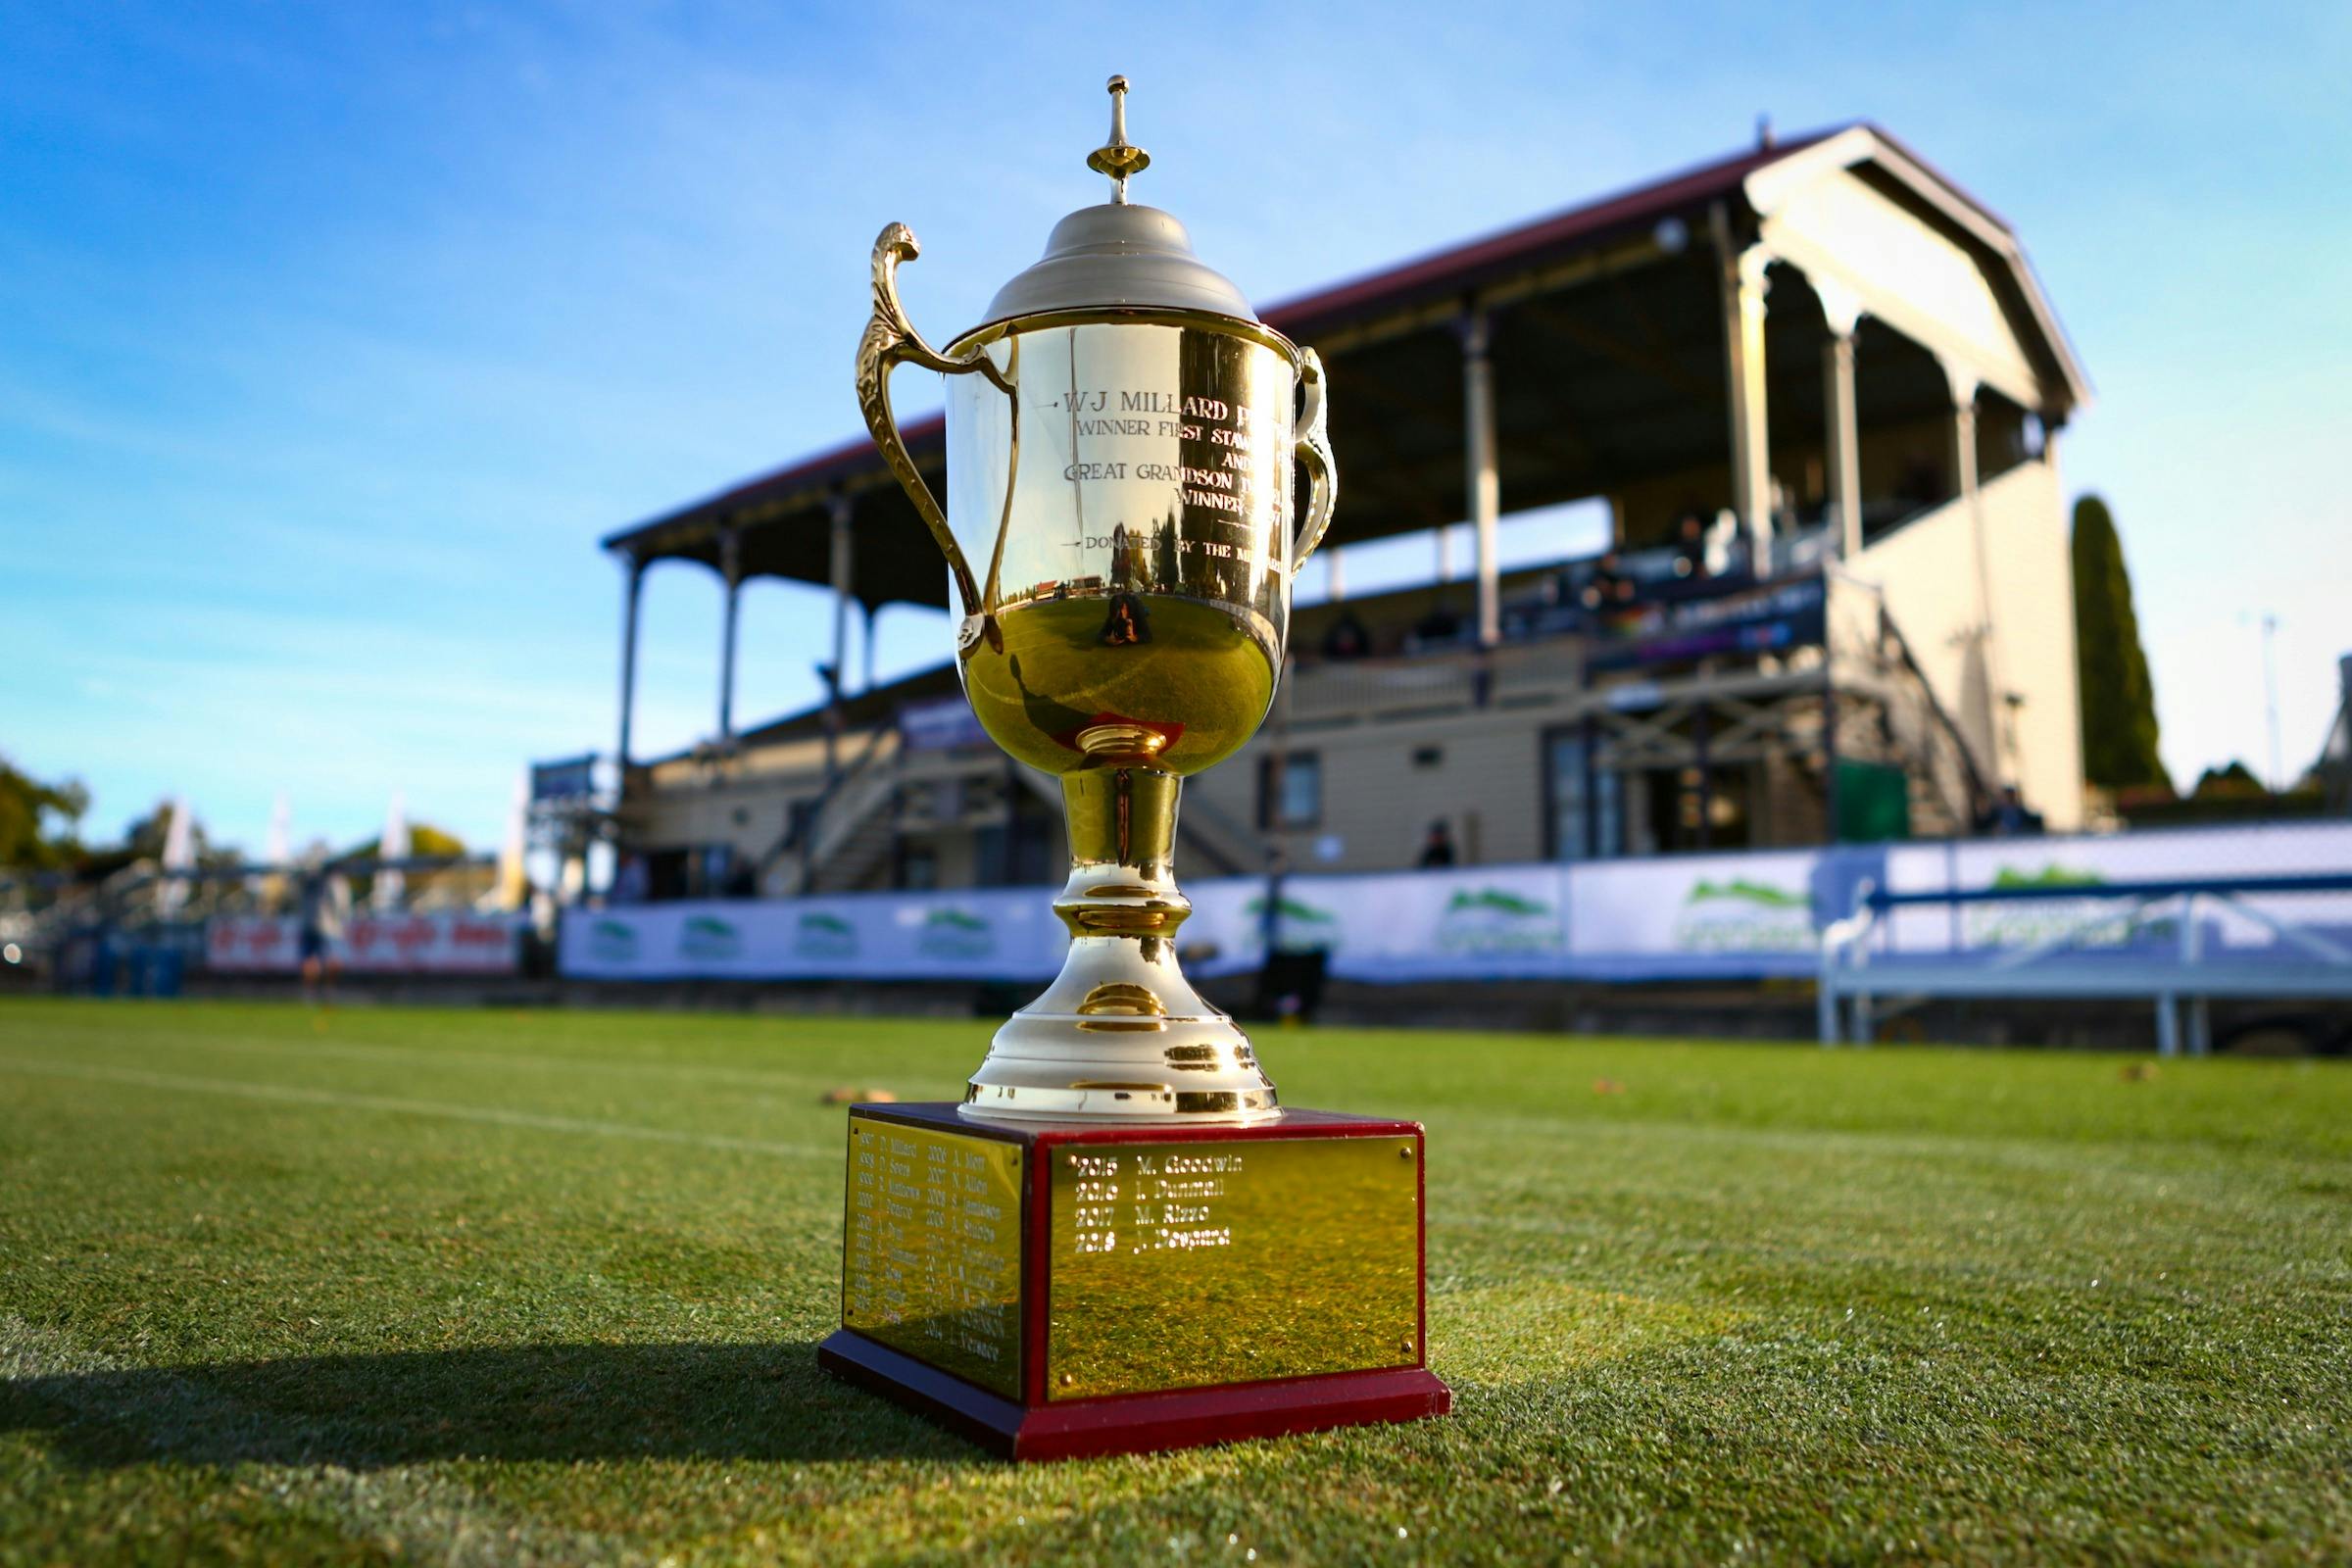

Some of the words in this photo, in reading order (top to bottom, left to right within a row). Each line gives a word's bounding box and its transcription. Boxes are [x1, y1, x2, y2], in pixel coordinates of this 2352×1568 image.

[1120, 391, 1228, 421] MILLARD
[1076, 419, 1151, 436] WINNER
[1158, 420, 1203, 442] FIRST
[1063, 463, 1127, 482] GREAT
[1136, 464, 1233, 490] GRANDSON
[1086, 536, 1162, 551] DONATED
[1174, 539, 1196, 553] BY
[1202, 541, 1232, 559] THE
[1078, 1156, 1117, 1176] 2015
[1165, 1154, 1242, 1174] Goodwin
[1076, 1182, 1118, 1201] 2016
[1076, 1206, 1114, 1227] 2017
[1163, 1203, 1209, 1223] Rizzo
